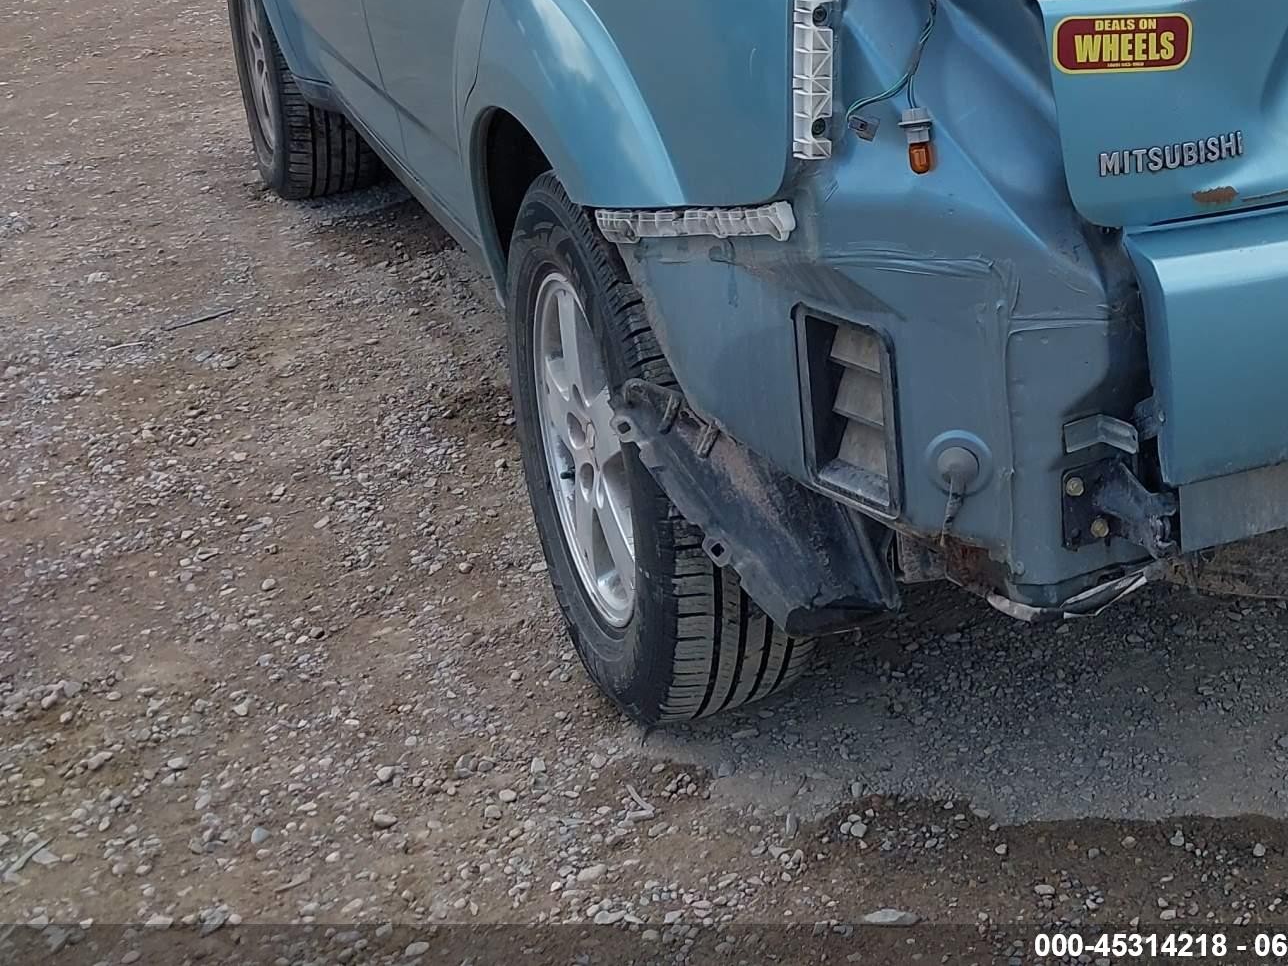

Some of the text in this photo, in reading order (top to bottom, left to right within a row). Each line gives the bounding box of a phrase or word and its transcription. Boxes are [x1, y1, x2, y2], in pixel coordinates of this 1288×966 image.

[1095, 19, 1157, 31] DEALS ON
[1074, 32, 1175, 63] WHEELS
[1100, 131, 1243, 177] MITSUBISHI
